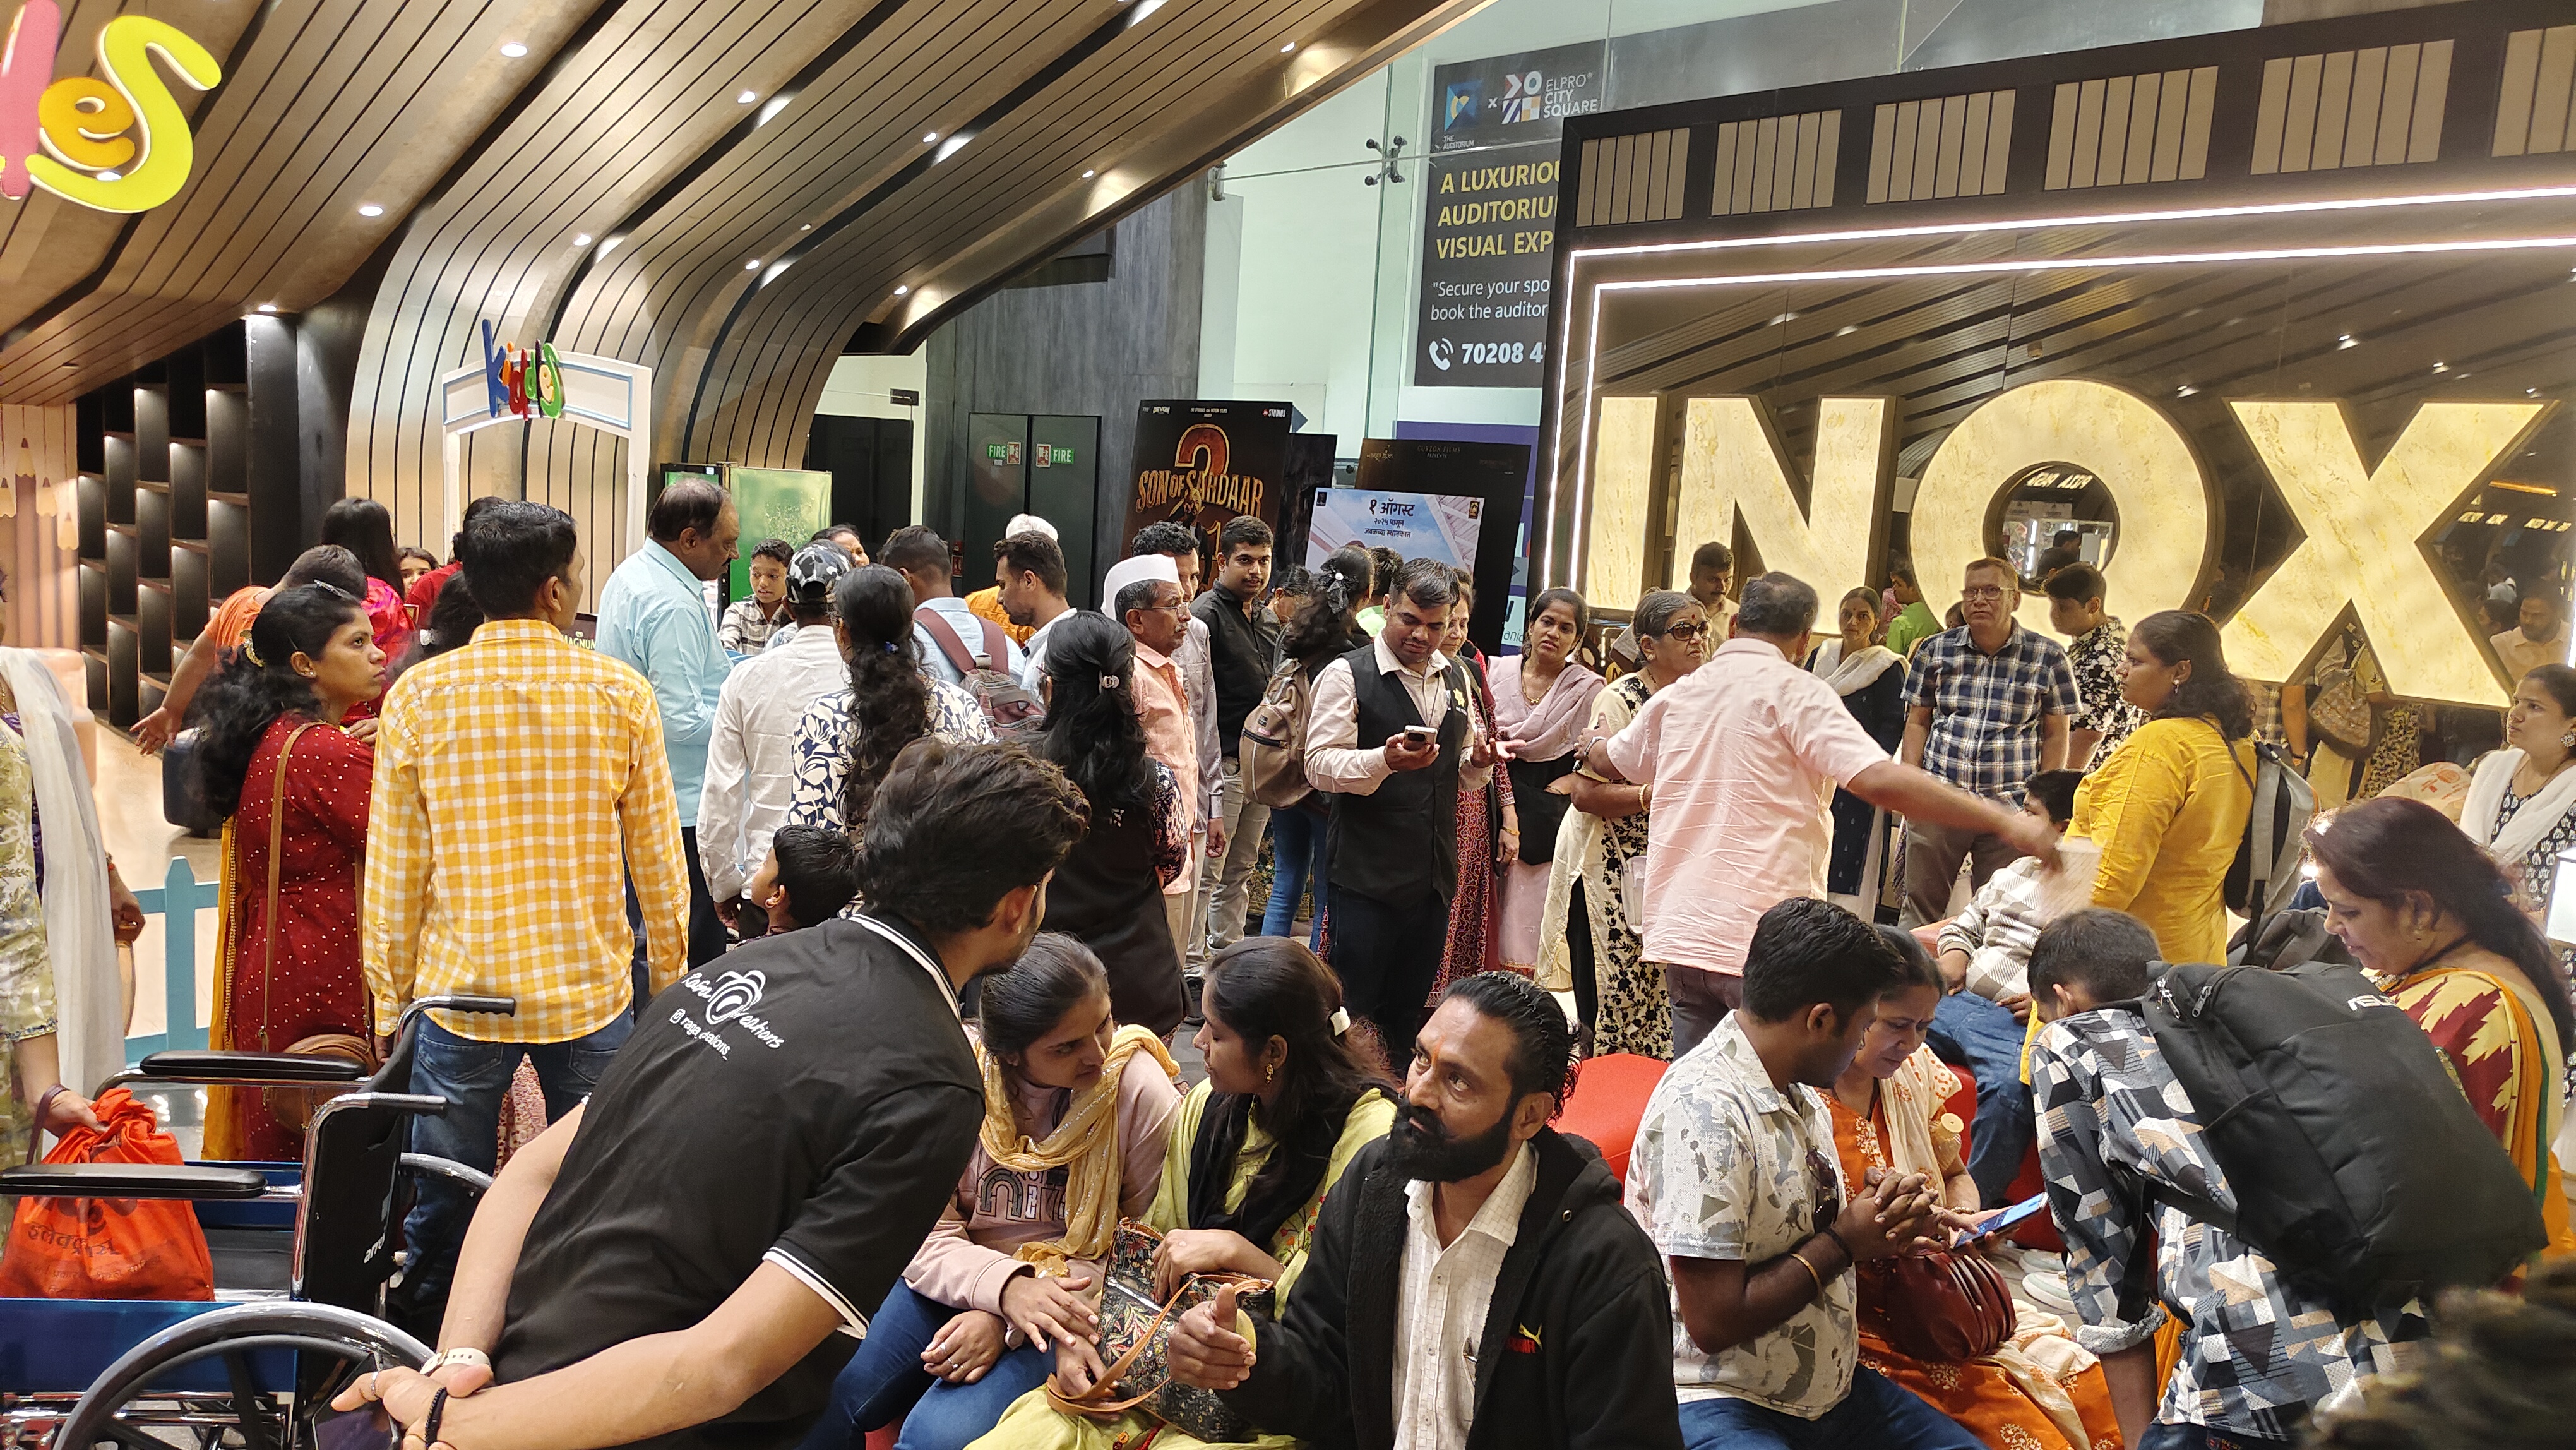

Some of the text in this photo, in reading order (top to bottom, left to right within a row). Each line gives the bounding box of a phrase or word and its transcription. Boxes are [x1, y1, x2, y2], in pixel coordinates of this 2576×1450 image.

[1545, 90, 1574, 105] CITY
[1543, 99, 1599, 119] SQUARE
[1440, 172, 1455, 195] A
[1437, 195, 1558, 227] AUDITORIU
[1436, 230, 1554, 260] VISUAL EXP
[1486, 280, 1519, 300] your
[1431, 304, 1465, 321] book
[1469, 301, 1491, 320] the
[1461, 342, 1524, 365] 70208
[989, 445, 1006, 458] FIRE
[1052, 449, 1072, 462] FIRE
[1135, 470, 1172, 513] SON
[1169, 474, 1185, 498] OF
[1369, 498, 1416, 517] १ ऑगस्ट
[1374, 518, 1388, 526] २०२५
[1585, 379, 2546, 709] INOX
